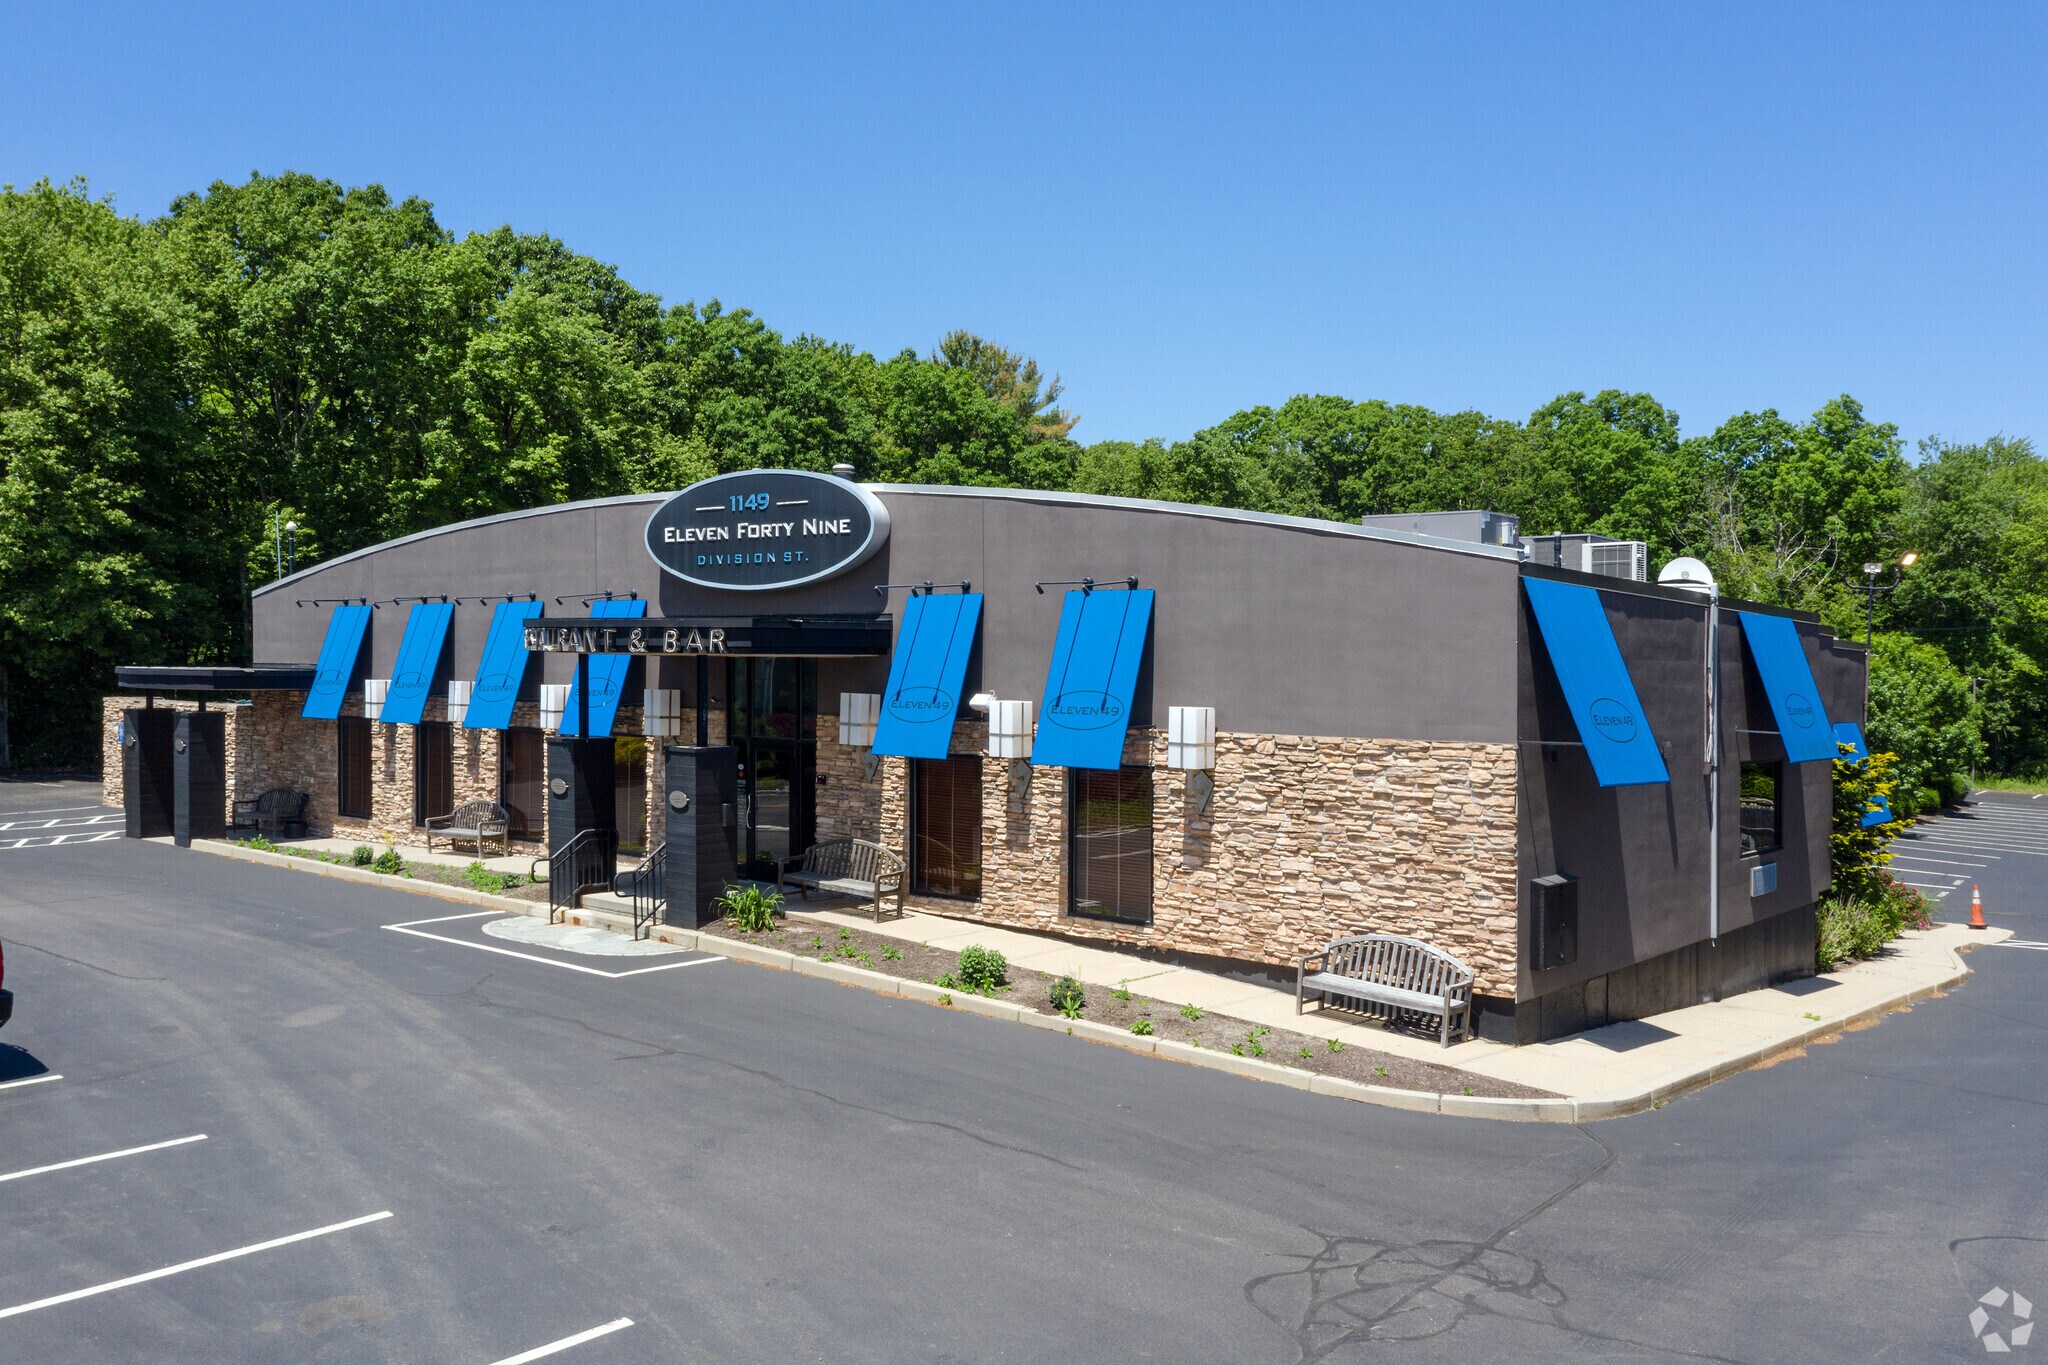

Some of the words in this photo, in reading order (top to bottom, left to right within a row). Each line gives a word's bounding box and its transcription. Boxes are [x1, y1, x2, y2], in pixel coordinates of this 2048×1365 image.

[729, 492, 770, 512] 1149
[664, 526, 729, 543] ELEVEN
[737, 522, 795, 539] FORTY
[802, 518, 851, 536] NINE
[697, 552, 776, 565] DIVISION
[783, 551, 809, 563] ST.
[628, 627, 649, 653] &
[663, 627, 729, 653] BAR
[891, 700, 932, 710] ELEVEN
[933, 701, 949, 711] 49
[1051, 704, 1099, 716] ELEVEN
[1100, 706, 1120, 717] 49
[1593, 714, 1622, 726] ELEVEN
[1623, 715, 1634, 726] 49
